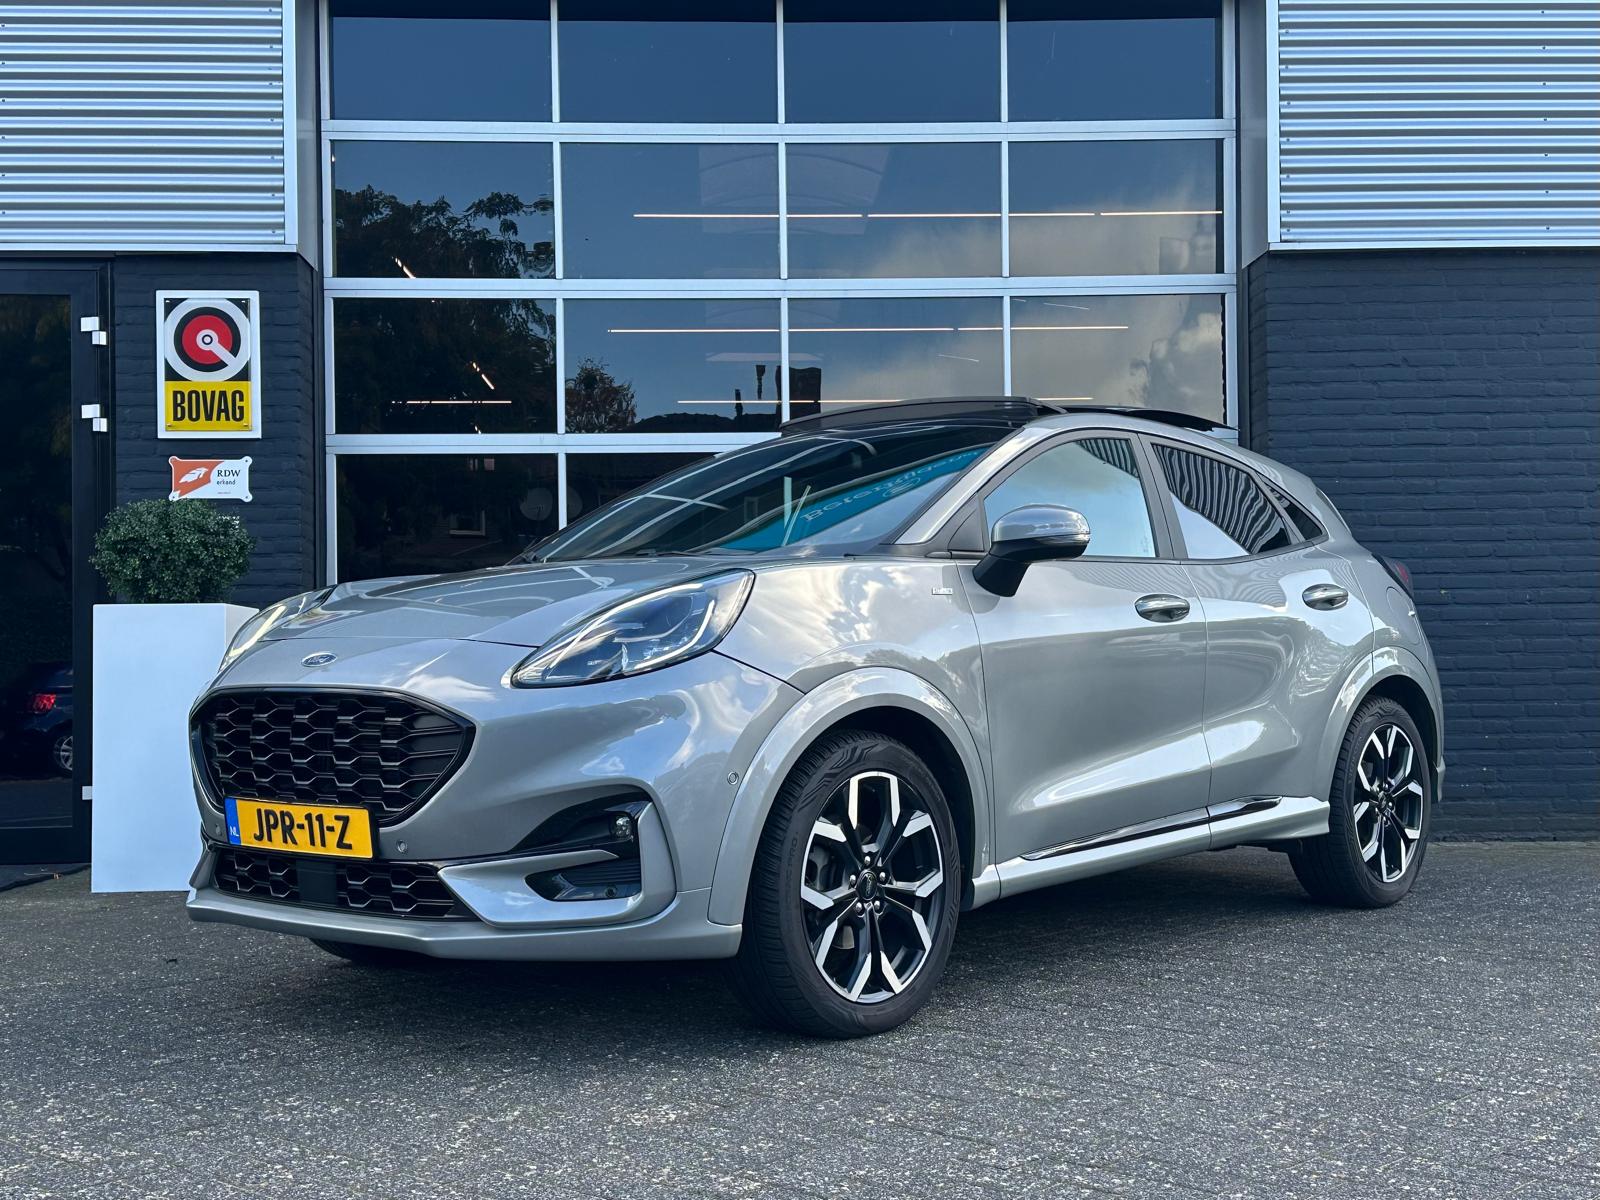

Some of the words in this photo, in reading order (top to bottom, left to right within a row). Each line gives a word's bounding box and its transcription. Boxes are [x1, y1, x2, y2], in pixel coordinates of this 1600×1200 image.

[172, 389, 245, 422] BOVAG
[217, 469, 241, 477] RDW
[229, 825, 240, 837] NL
[253, 807, 353, 850] JPR-11-Z
